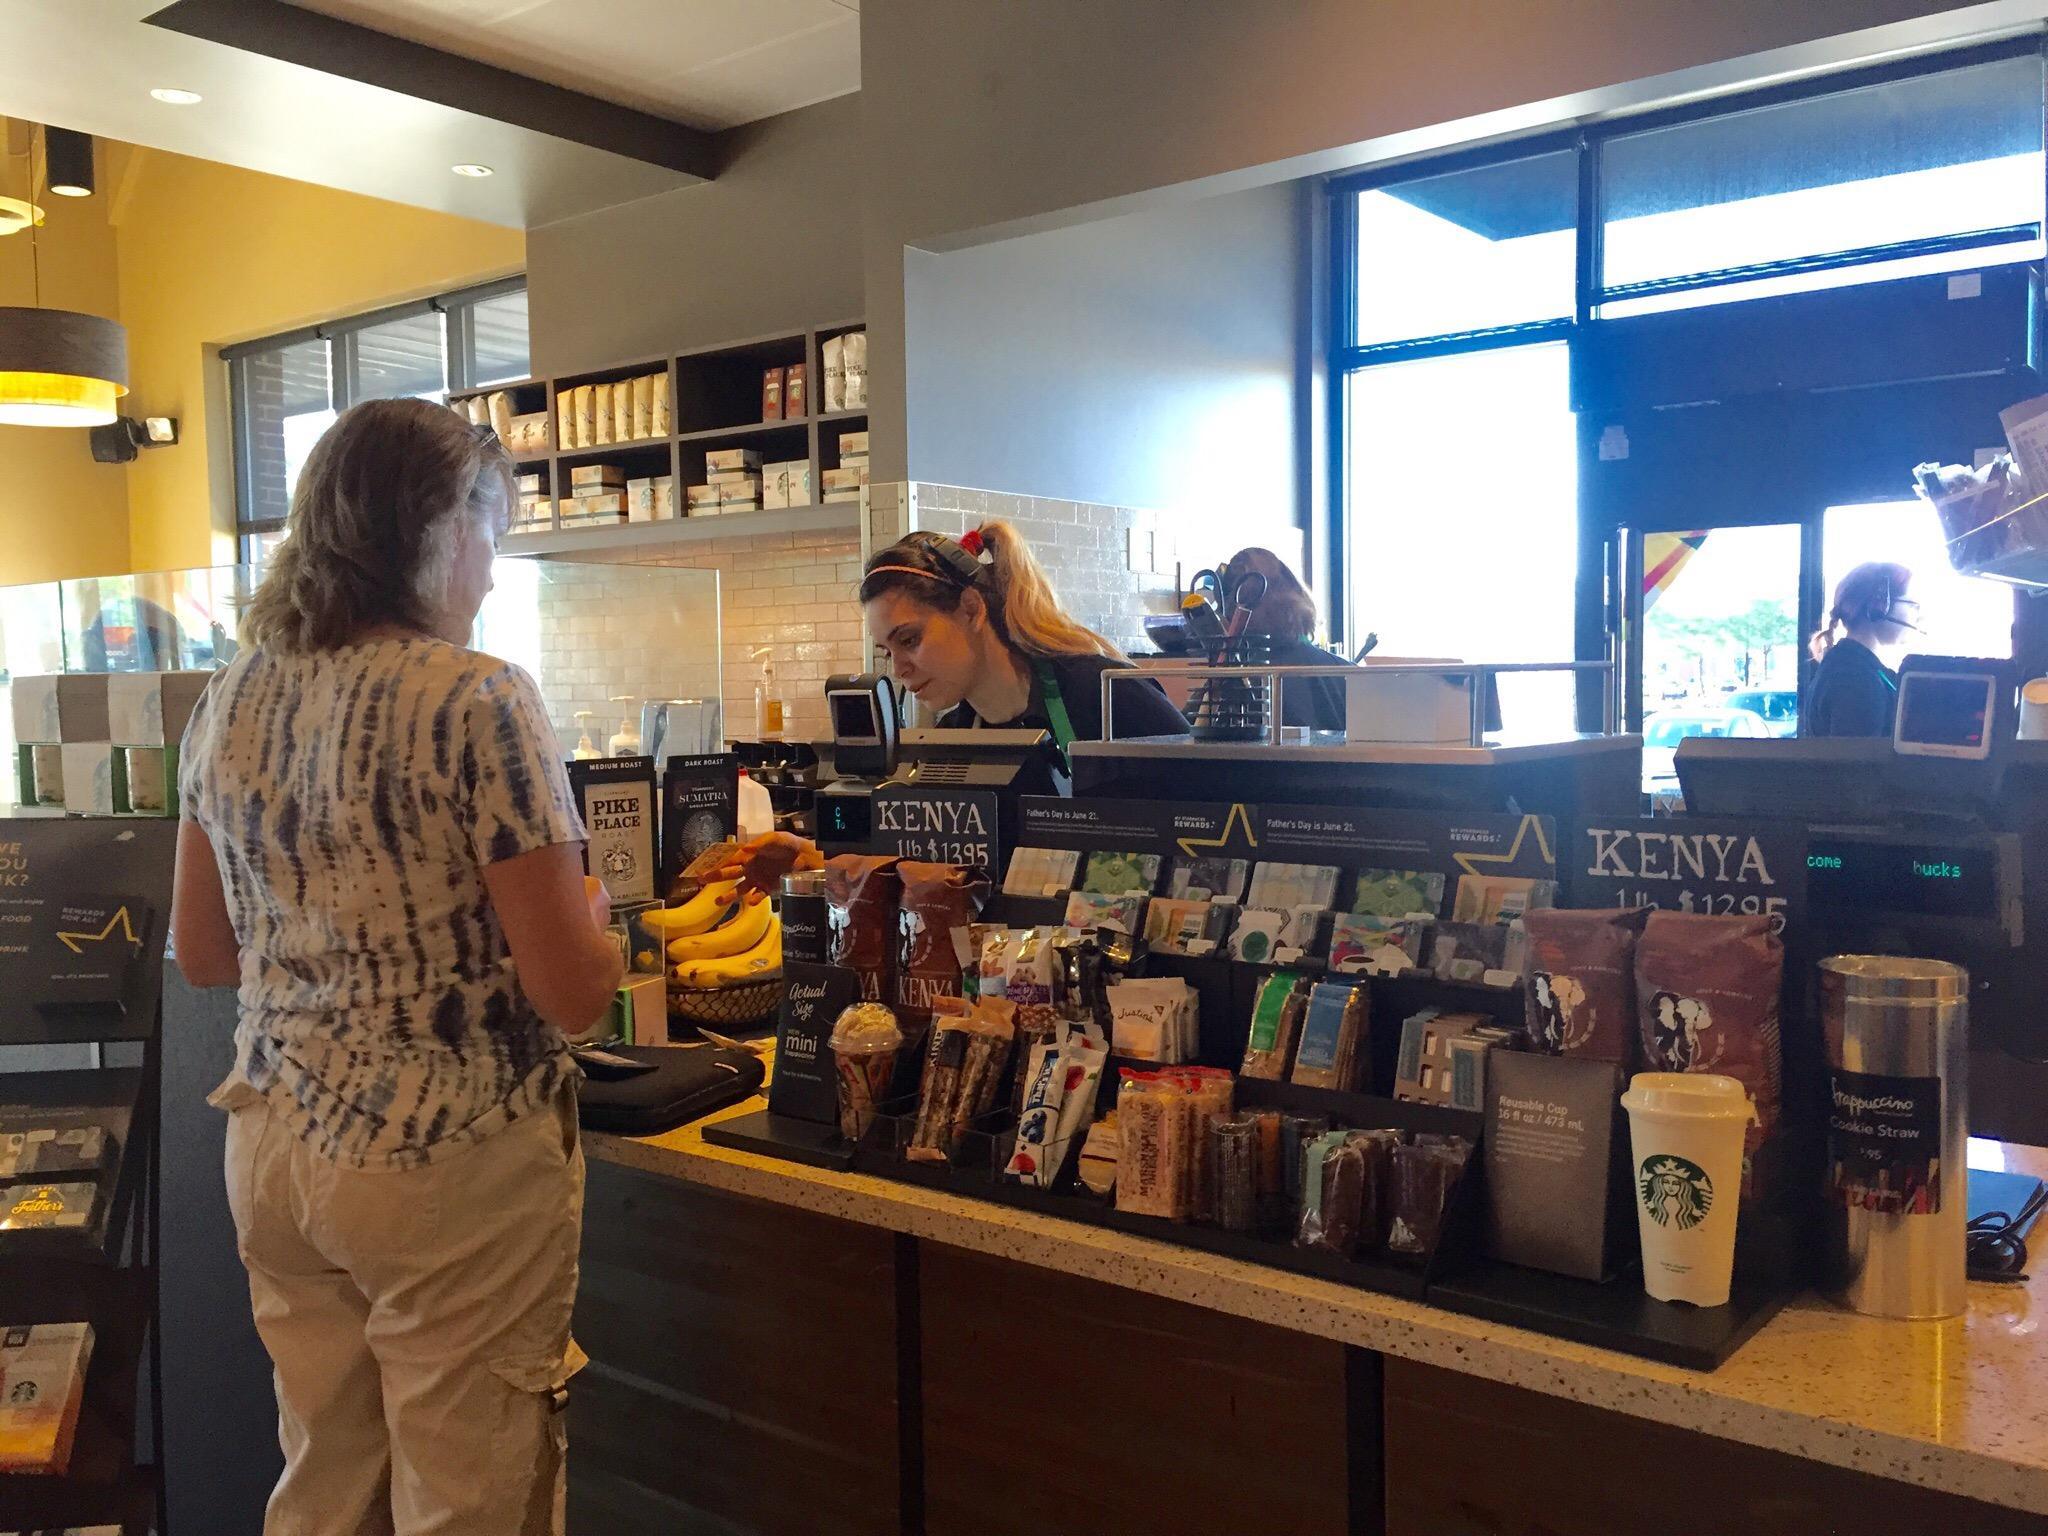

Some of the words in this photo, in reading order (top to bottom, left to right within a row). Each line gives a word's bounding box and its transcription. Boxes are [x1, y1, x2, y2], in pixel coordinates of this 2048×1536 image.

[589, 762, 618, 771] MEDIUM
[620, 761, 642, 769] ROAST
[684, 760, 702, 768] DARK
[703, 758, 724, 766] ROAST
[592, 797, 639, 816] PIKE
[679, 792, 728, 803] SUMATRA
[594, 816, 640, 831] PLACE
[877, 800, 988, 835] KENYA
[1026, 808, 1050, 818] Father's
[1052, 809, 1062, 820] Day
[1064, 811, 1071, 819] is
[1072, 811, 1087, 820] June
[1266, 819, 1296, 829] Father's
[1298, 820, 1312, 832] Day
[1313, 821, 1321, 830] is
[1323, 822, 1342, 831] June
[1586, 828, 1776, 885] KENYA
[1807, 856, 1842, 869] come
[1913, 860, 1962, 878] bucks
[1, 914, 33, 923] FOOD
[789, 980, 828, 1001] Actual
[898, 975, 955, 1009] KENYA
[791, 1000, 815, 1022] Size
[786, 1033, 818, 1053] mini
[1499, 1094, 1545, 1112] Reusable
[1547, 1102, 1568, 1118] Cup
[1497, 1107, 1510, 1120] 16
[1512, 1109, 1521, 1121] fl
[1522, 1113, 1534, 1124] oz
[1544, 1114, 1565, 1128] 473
[1567, 1119, 1585, 1132] mL
[1830, 1115, 1874, 1135] Cookie
[1877, 1124, 1921, 1138] Straw
[11, 1199, 65, 1215] Father's
